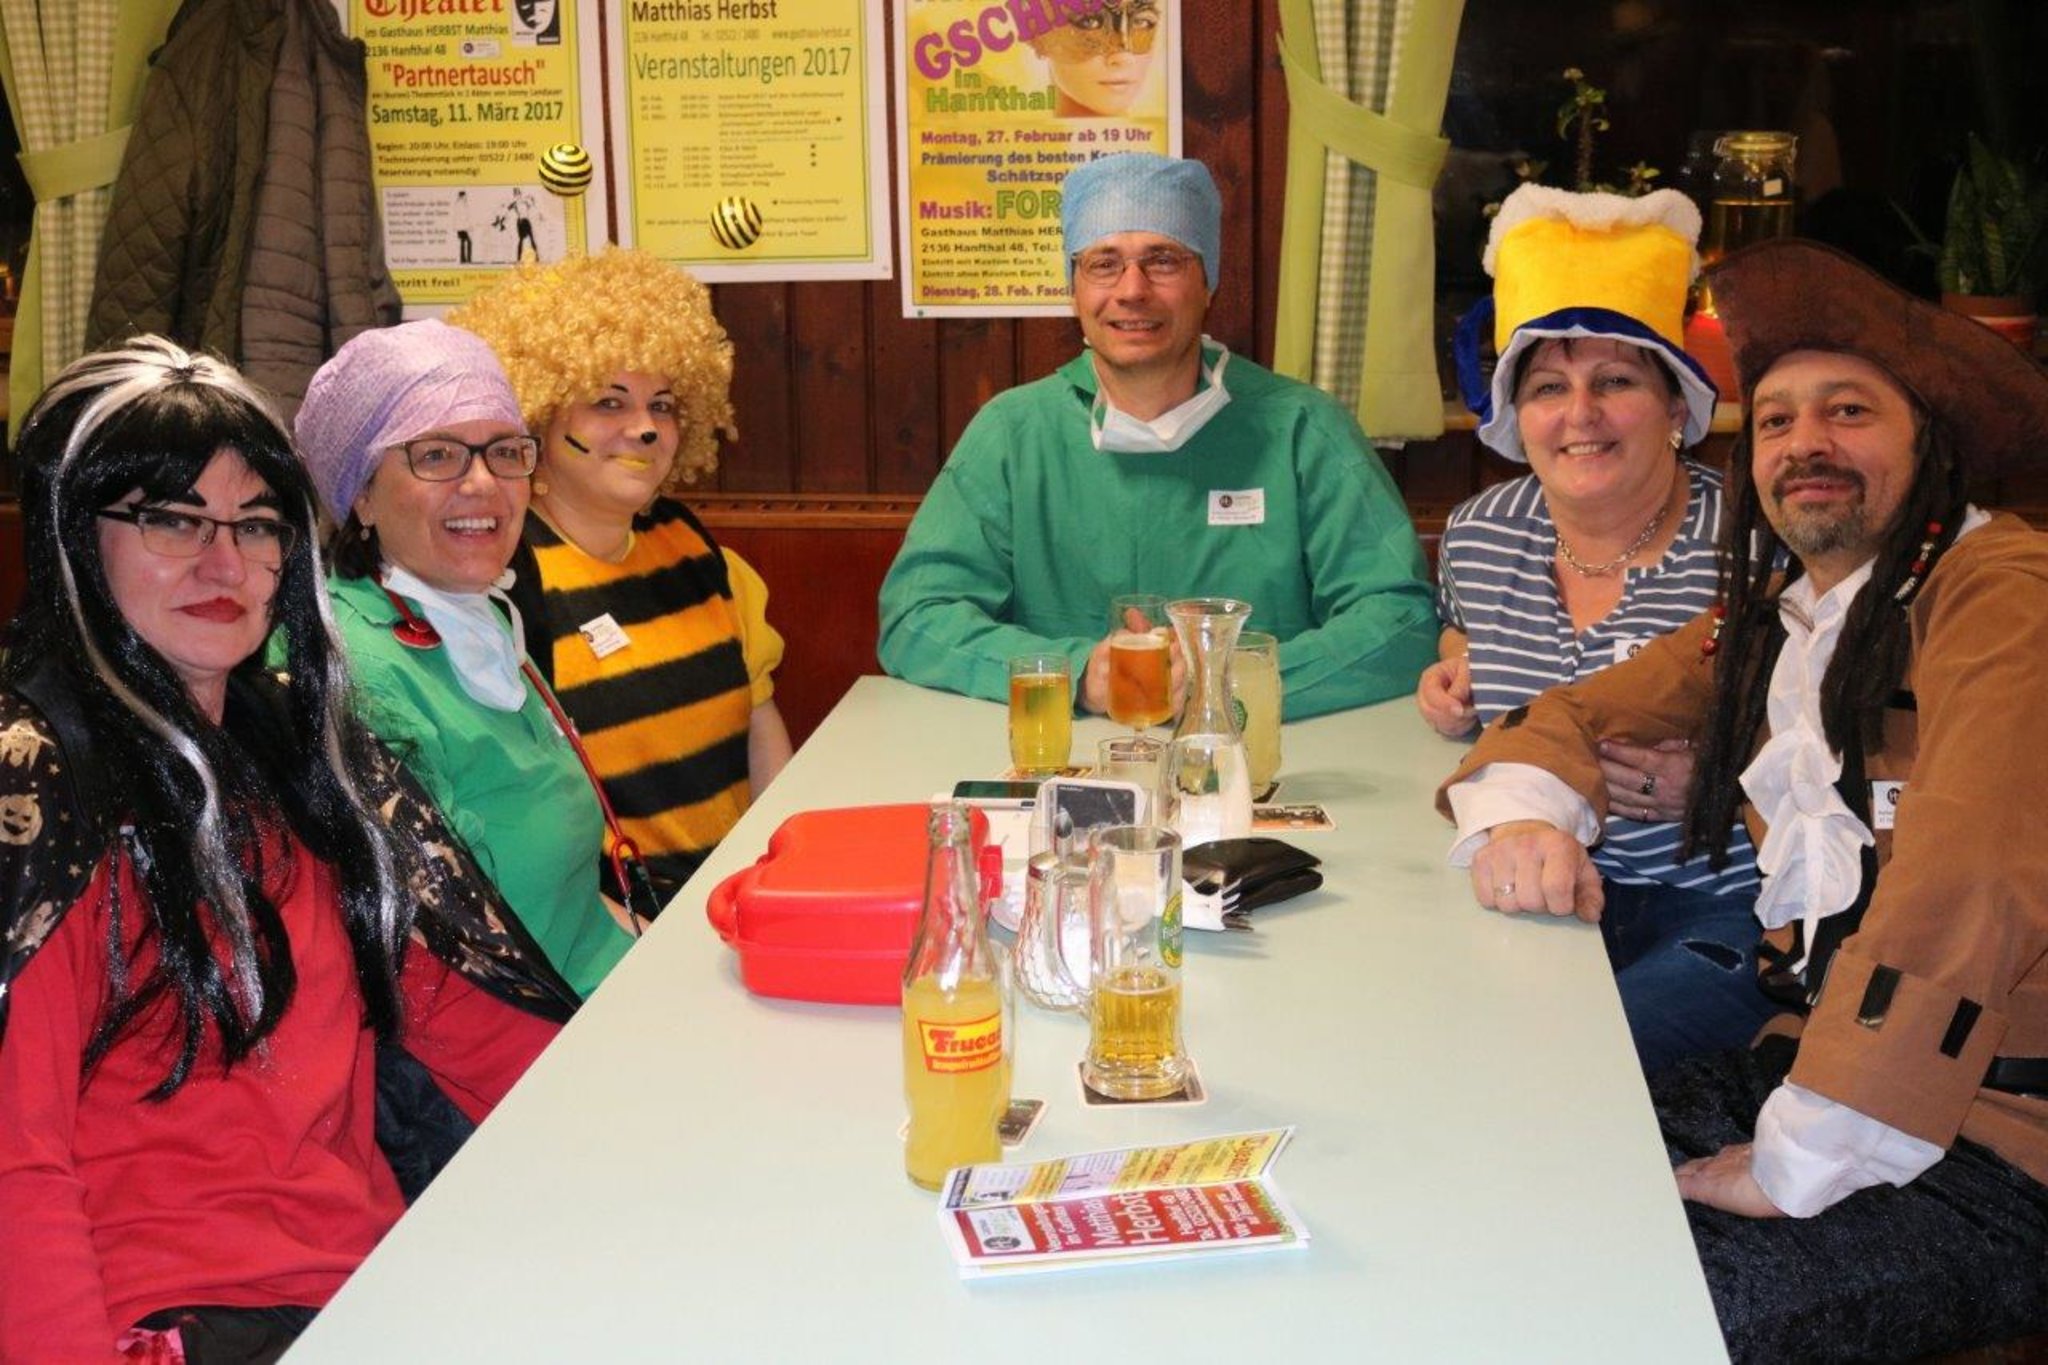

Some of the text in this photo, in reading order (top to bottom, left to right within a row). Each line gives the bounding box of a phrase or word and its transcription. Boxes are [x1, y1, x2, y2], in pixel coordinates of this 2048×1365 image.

[632, 0, 778, 22] Matthias Herbst
[380, 26, 423, 38] Gasthaus
[426, 25, 462, 36] HERBST
[465, 24, 509, 35] Matthias
[391, 45, 432, 57] Hanfthal
[435, 44, 447, 55] 48
[382, 60, 545, 87] "Partnertausch"
[633, 47, 852, 84] Veranstaltungen 2017
[926, 85, 1057, 113] Hanfthal
[372, 101, 564, 127] Samstag, 11. März 2017
[511, 140, 528, 149] Uhr
[921, 128, 1152, 146] Montag, 27. Februar ab 19 Uhr
[921, 151, 1003, 168] Prämierung
[1007, 151, 1033, 165] des
[1036, 150, 1086, 164] besten
[919, 200, 993, 220] Musik:
[921, 226, 977, 238] Gasthaus
[981, 226, 1034, 237] Matthias
[921, 242, 951, 254] 2136
[954, 242, 1006, 253] Hanfthal
[431, 276, 461, 288] frei!
[922, 285, 980, 299] Dienstag,
[984, 284, 1003, 297] 28.
[1006, 284, 1033, 297] Feb.
[1111, 1190, 1171, 1244] Herbst
